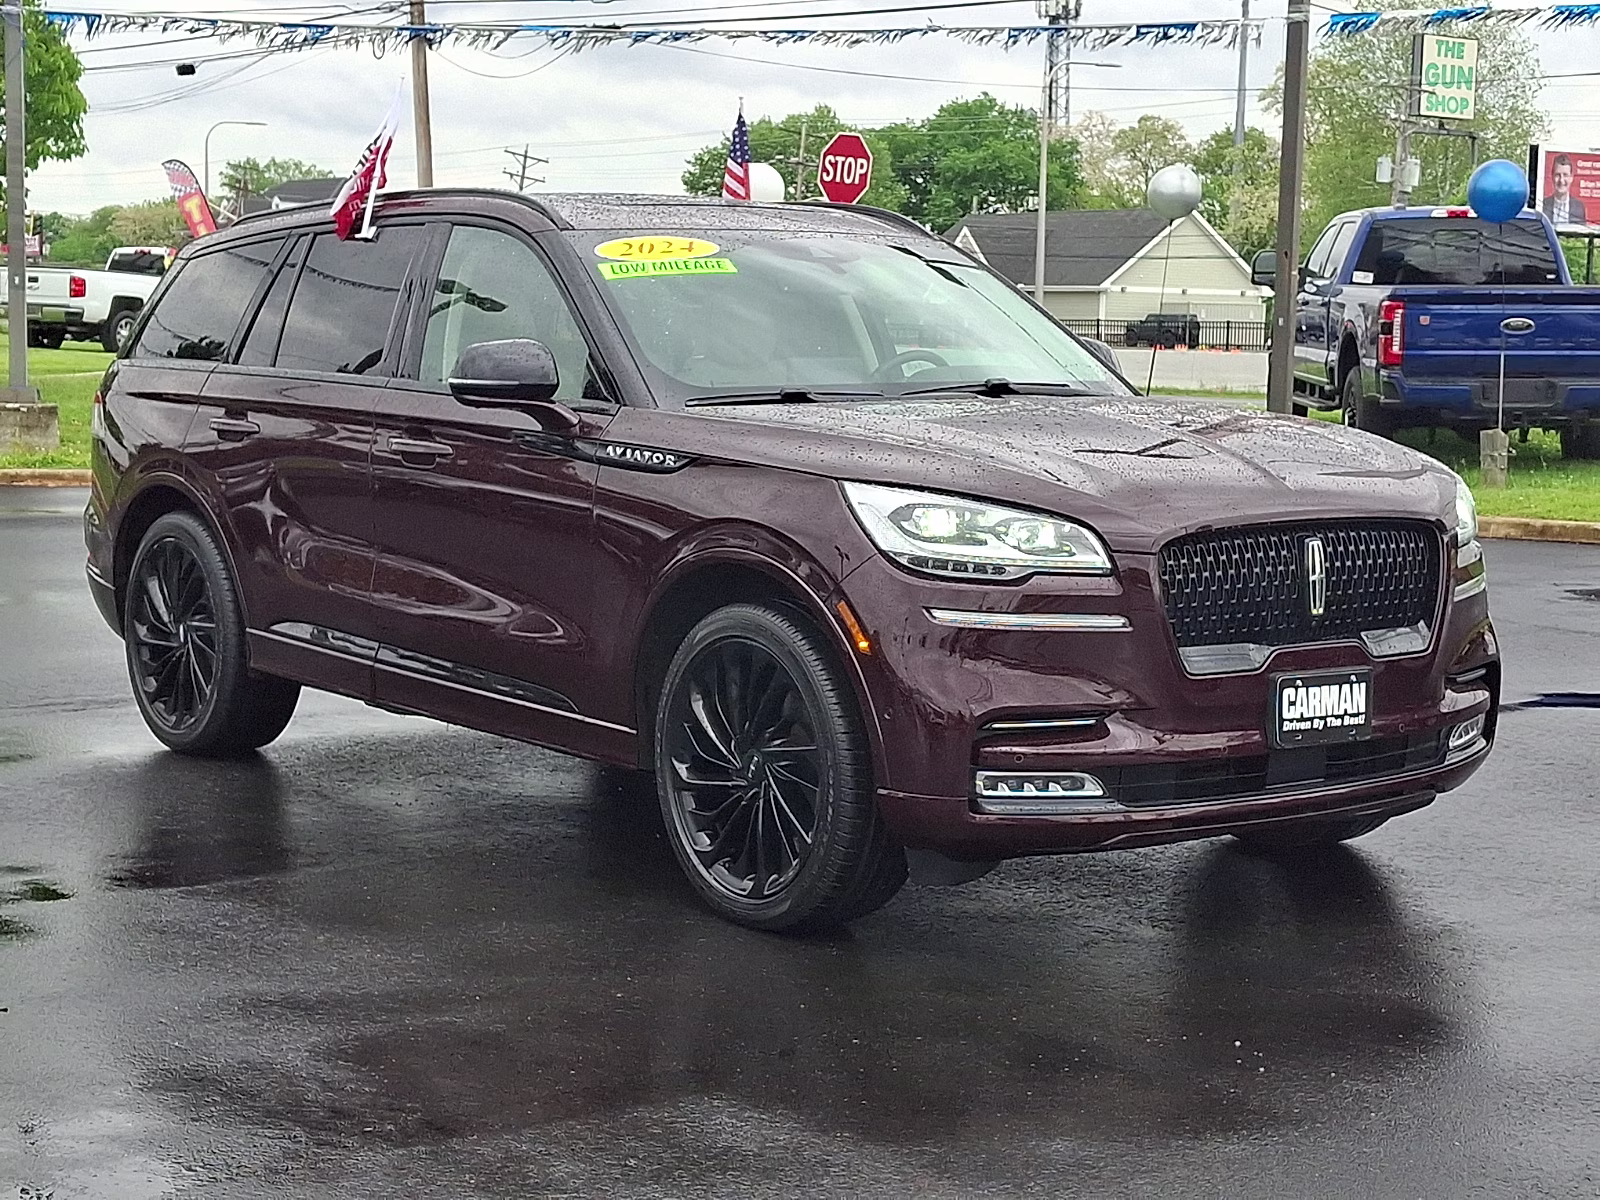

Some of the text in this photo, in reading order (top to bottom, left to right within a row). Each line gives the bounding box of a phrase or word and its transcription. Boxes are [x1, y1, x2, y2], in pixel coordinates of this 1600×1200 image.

[1436, 39, 1465, 60] THE
[1424, 62, 1474, 91] GUN
[1425, 95, 1470, 115] SHOP
[822, 154, 868, 185] STOP
[619, 241, 694, 256] 2024
[610, 260, 727, 275] LOW MILEAGE
[606, 445, 675, 466] AVIATOR
[1282, 682, 1366, 719] CARMAN
[1282, 720, 1311, 732] Driven
[1312, 718, 1325, 730] By
[1326, 716, 1342, 728] The
